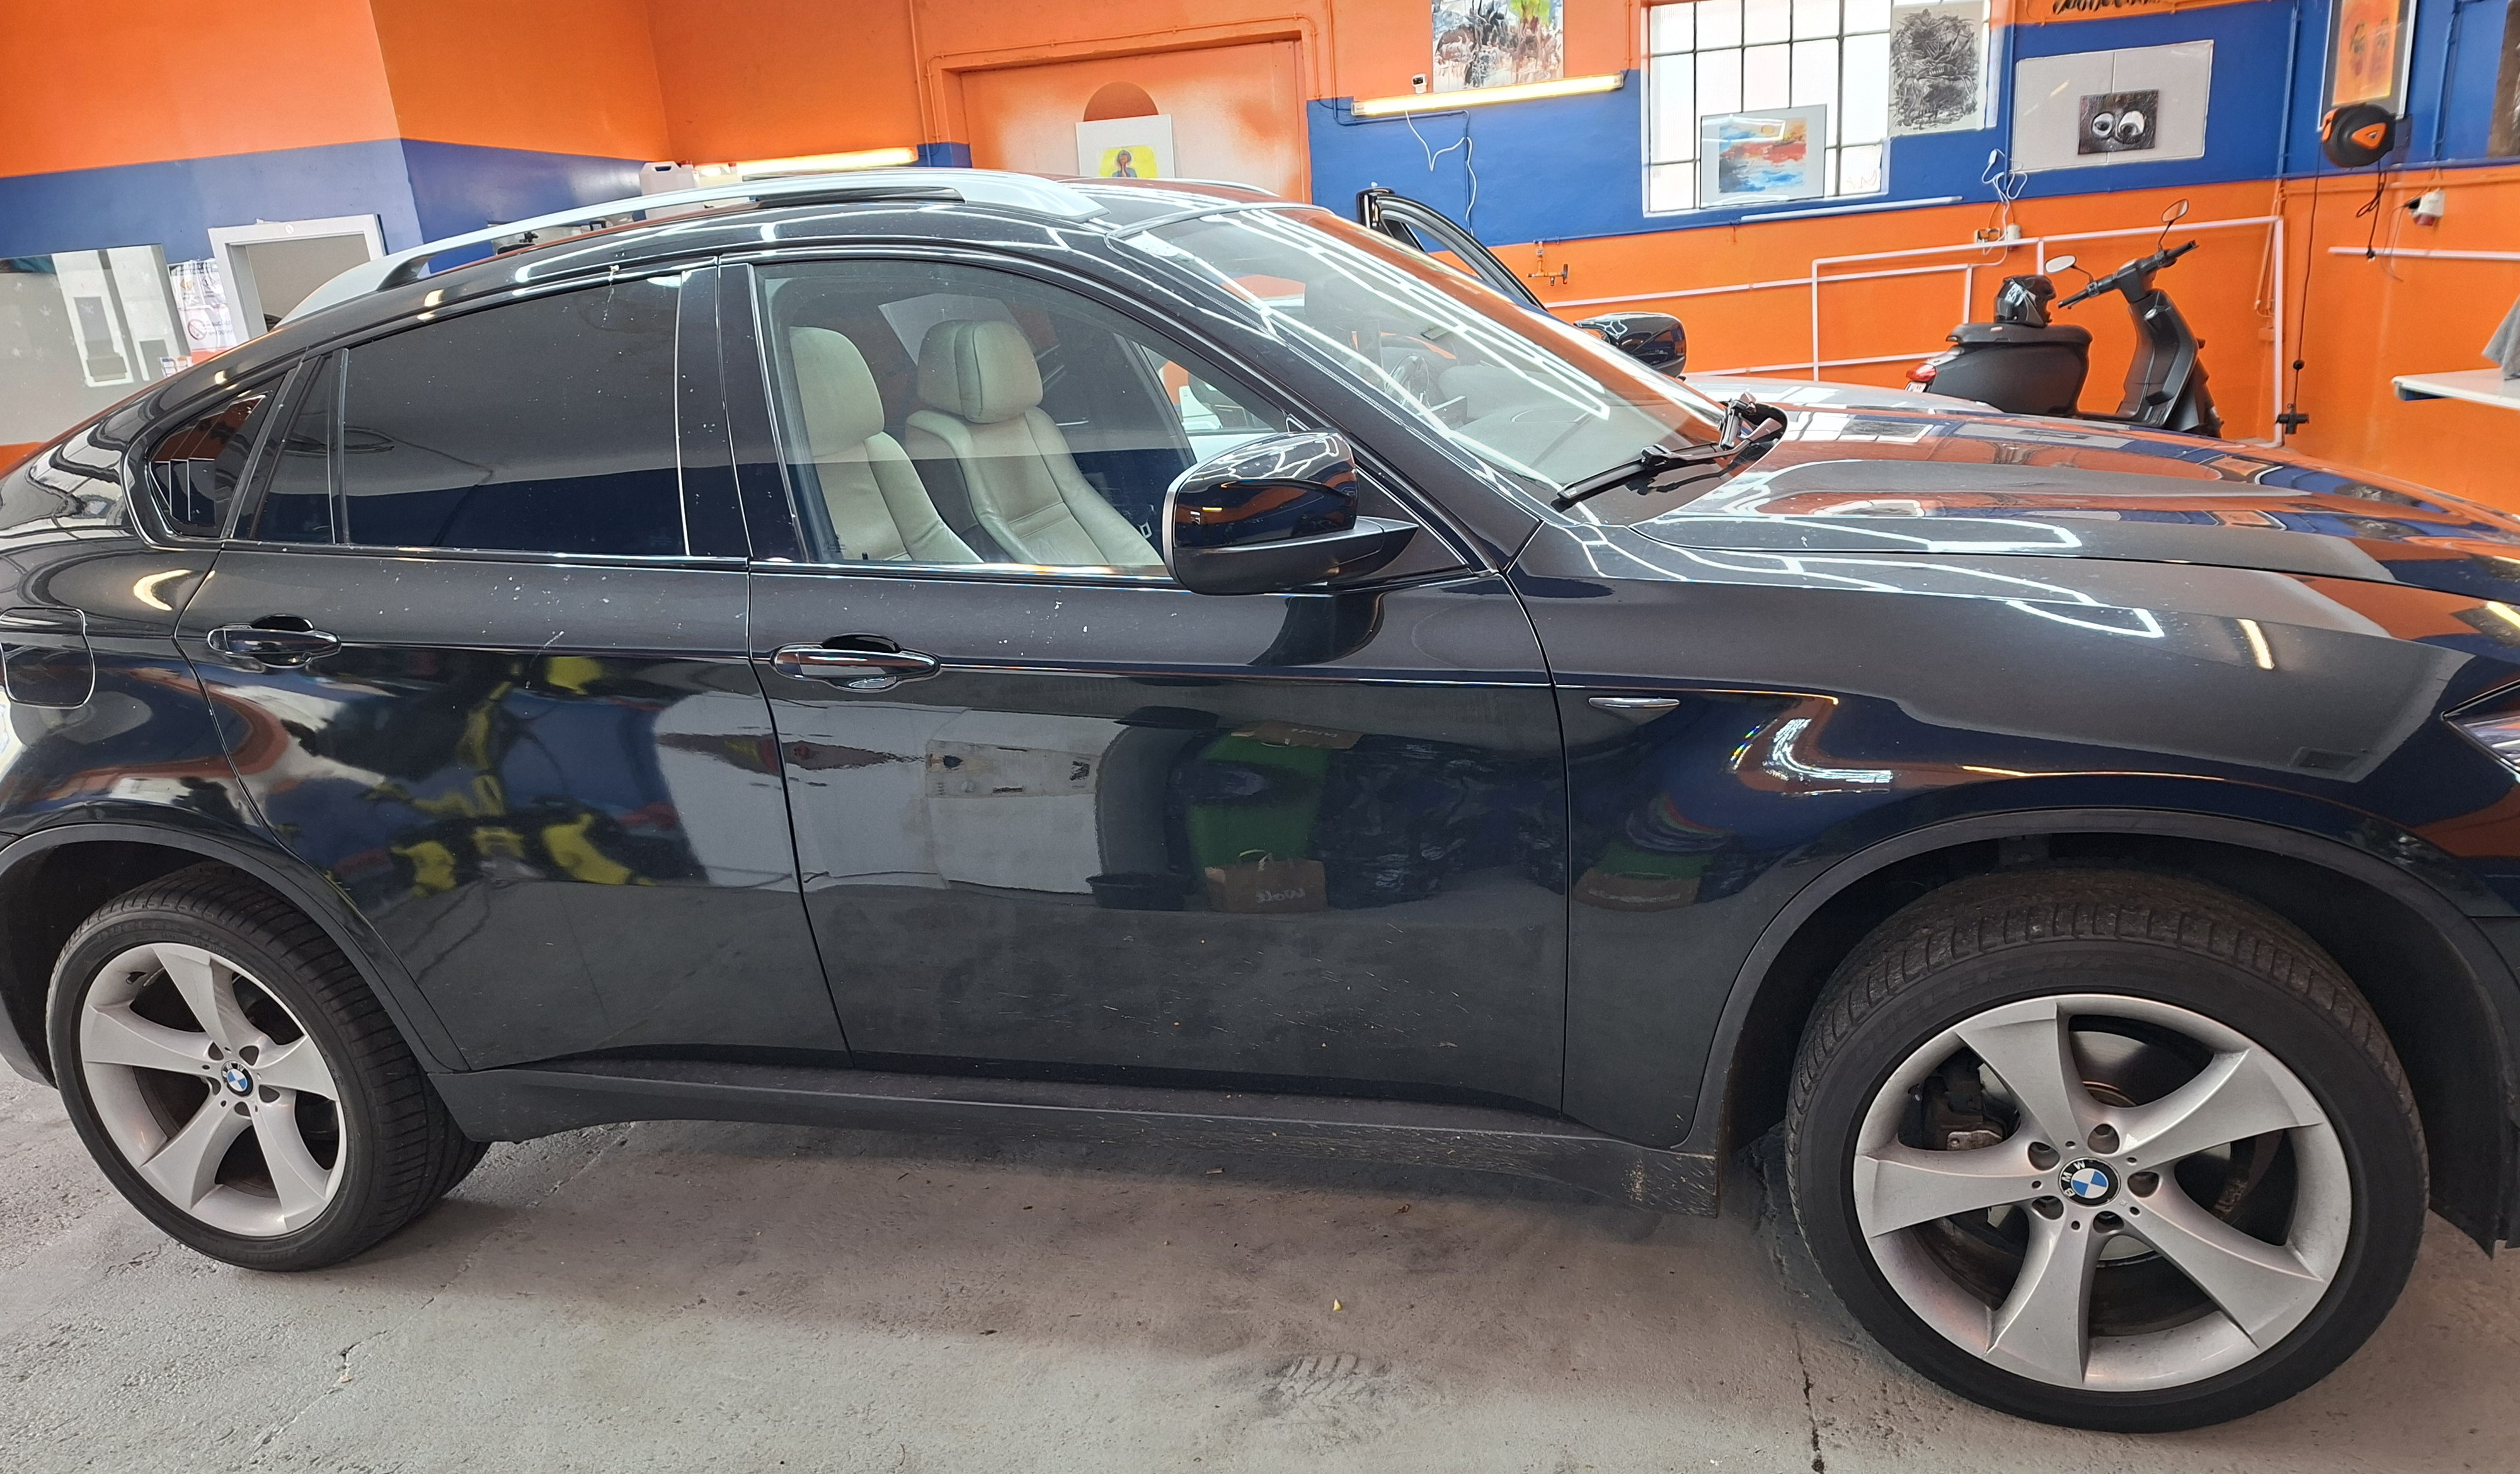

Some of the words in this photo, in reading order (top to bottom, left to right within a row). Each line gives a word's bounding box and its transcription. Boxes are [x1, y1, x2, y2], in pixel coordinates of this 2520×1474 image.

[1855, 965, 2007, 1063] DUELER
[222, 1062, 244, 1078] BMW
[2061, 1160, 2086, 1197] BMW
